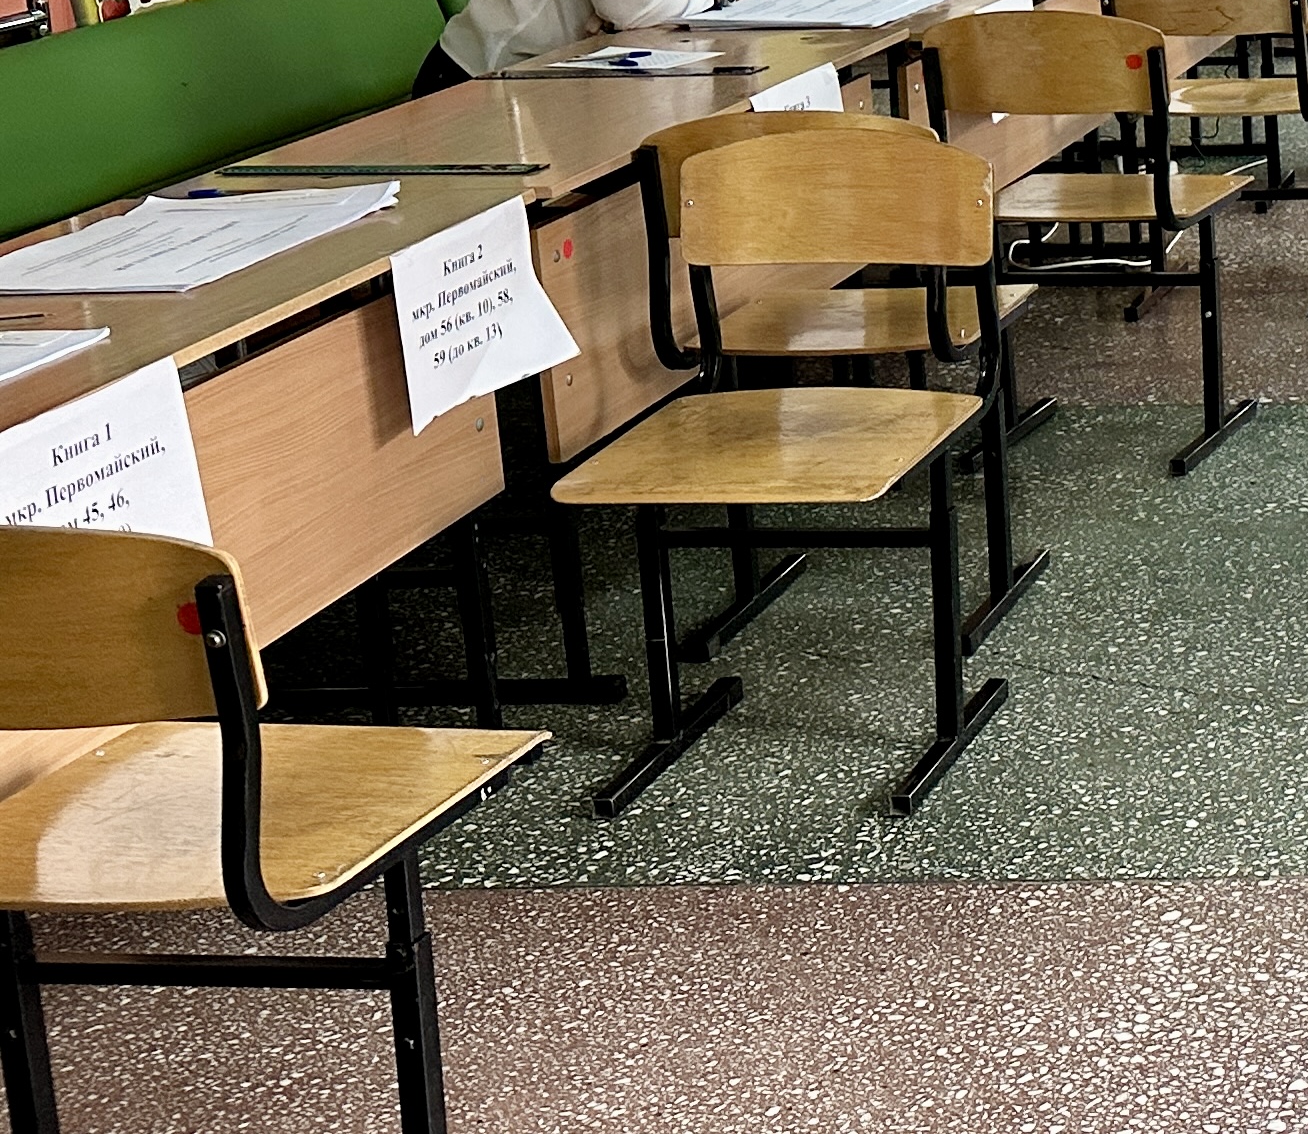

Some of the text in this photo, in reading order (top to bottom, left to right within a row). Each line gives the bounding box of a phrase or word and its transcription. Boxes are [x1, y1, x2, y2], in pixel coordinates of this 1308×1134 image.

[443, 244, 483, 277] Книга 2
[411, 258, 517, 323] мкр. Первомайский,
[419, 288, 514, 349] дом 56 (кв. 10), 58,
[433, 322, 503, 369] 59 (до кв. 13)
[52, 422, 112, 468] Книга 1
[5, 435, 166, 527] мкр. Первомайский,
[82, 488, 130, 525] 45, 46,
